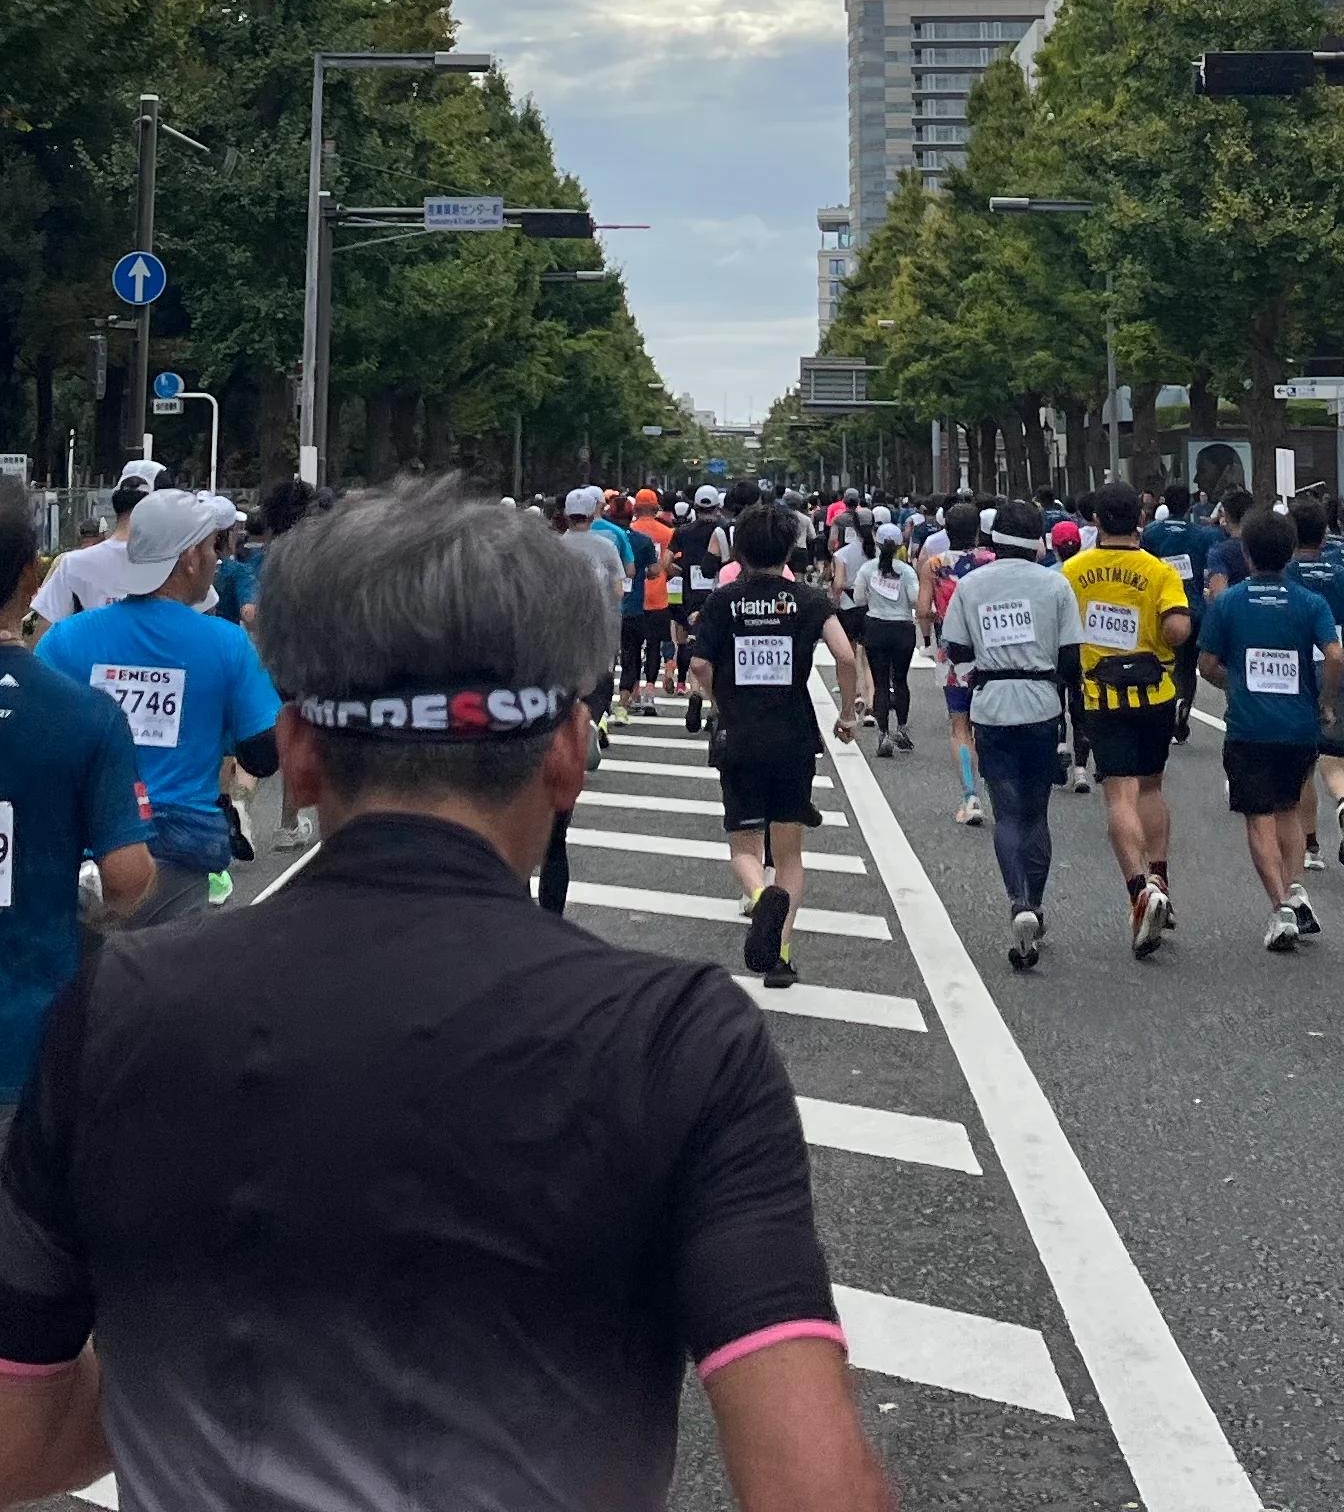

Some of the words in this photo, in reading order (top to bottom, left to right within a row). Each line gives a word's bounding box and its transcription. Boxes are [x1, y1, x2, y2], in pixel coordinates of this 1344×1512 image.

[1078, 567, 1149, 591] DORTMUND
[730, 596, 797, 618] triathlon
[982, 611, 1031, 631] G15108
[1088, 614, 1136, 634] G16083
[738, 651, 790, 665] G16812
[118, 670, 171, 684] ENEOS
[1249, 661, 1297, 677] F14108
